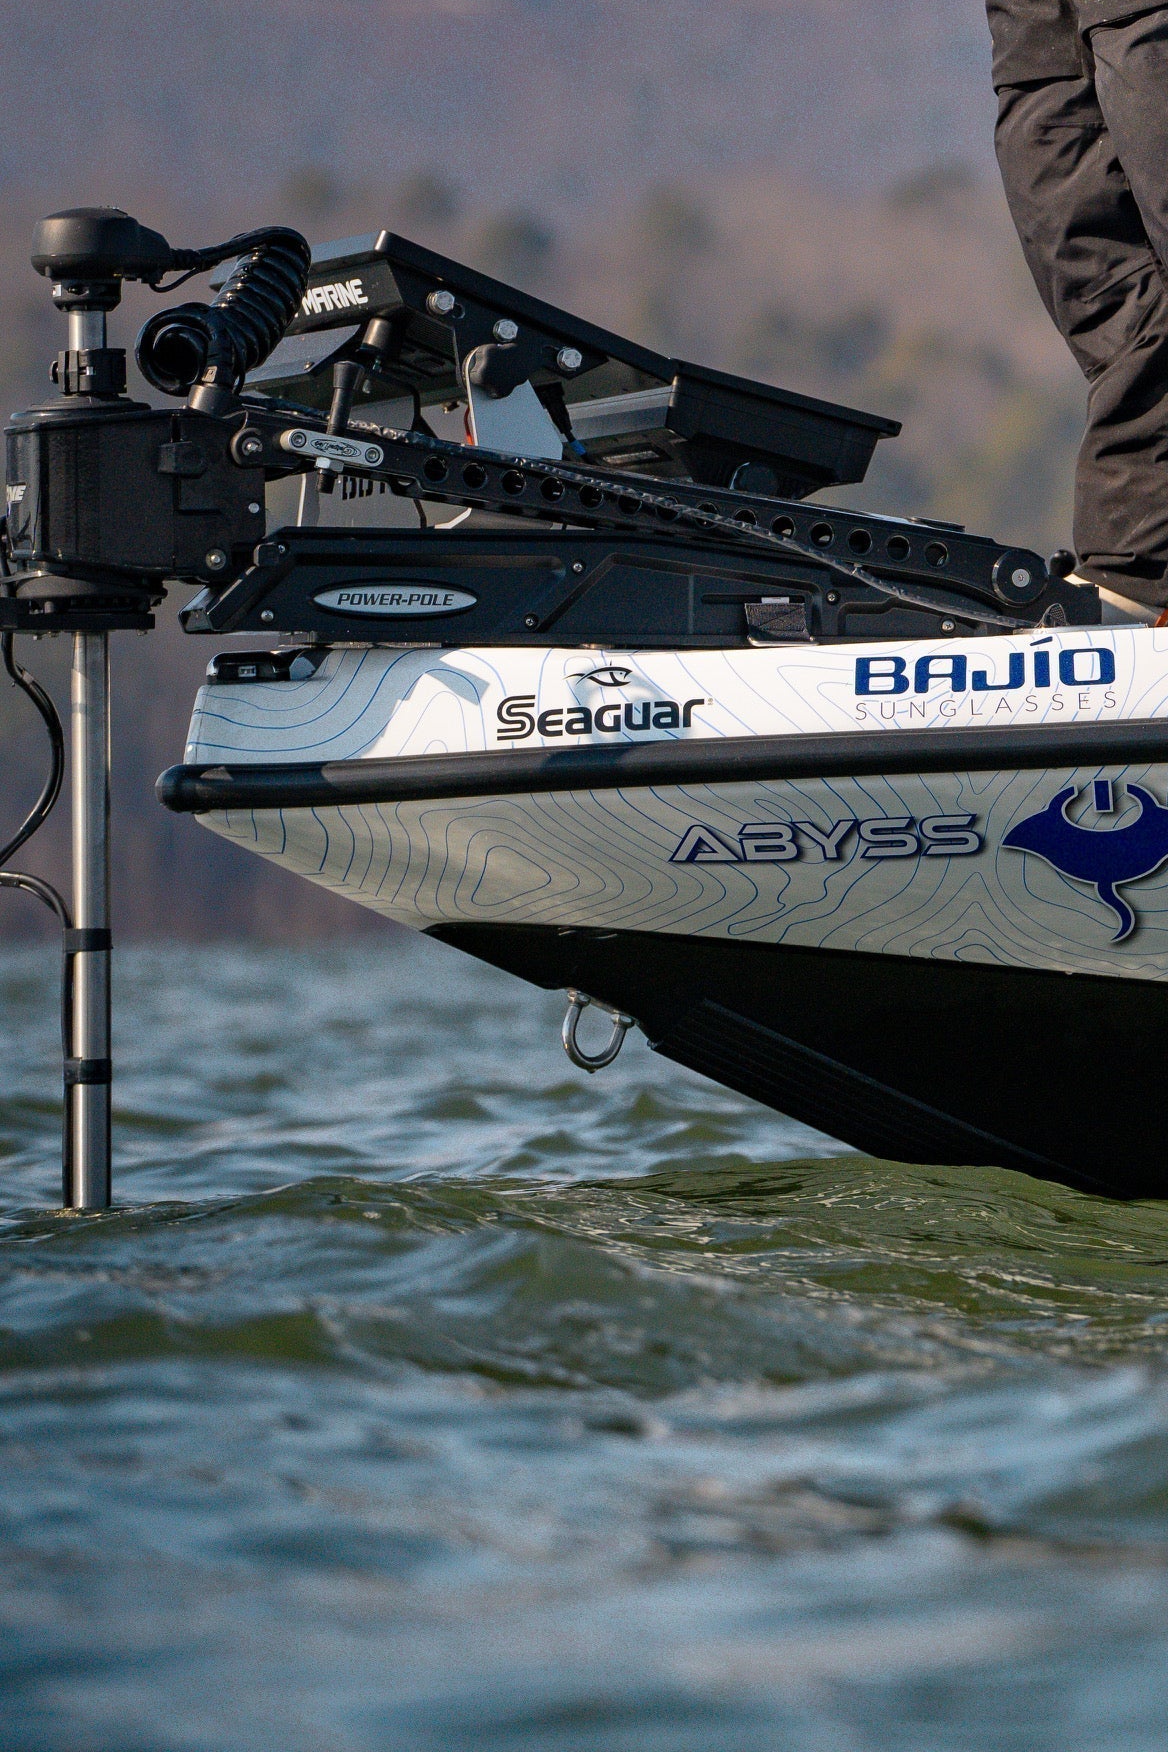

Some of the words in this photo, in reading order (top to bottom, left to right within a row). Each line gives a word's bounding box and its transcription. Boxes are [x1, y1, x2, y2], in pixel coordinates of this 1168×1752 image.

[301, 278, 369, 316] MARINE
[337, 593, 454, 606] POWER-POLE
[855, 691, 1117, 720] SUNGLASSES
[668, 813, 984, 863] ABYSS
